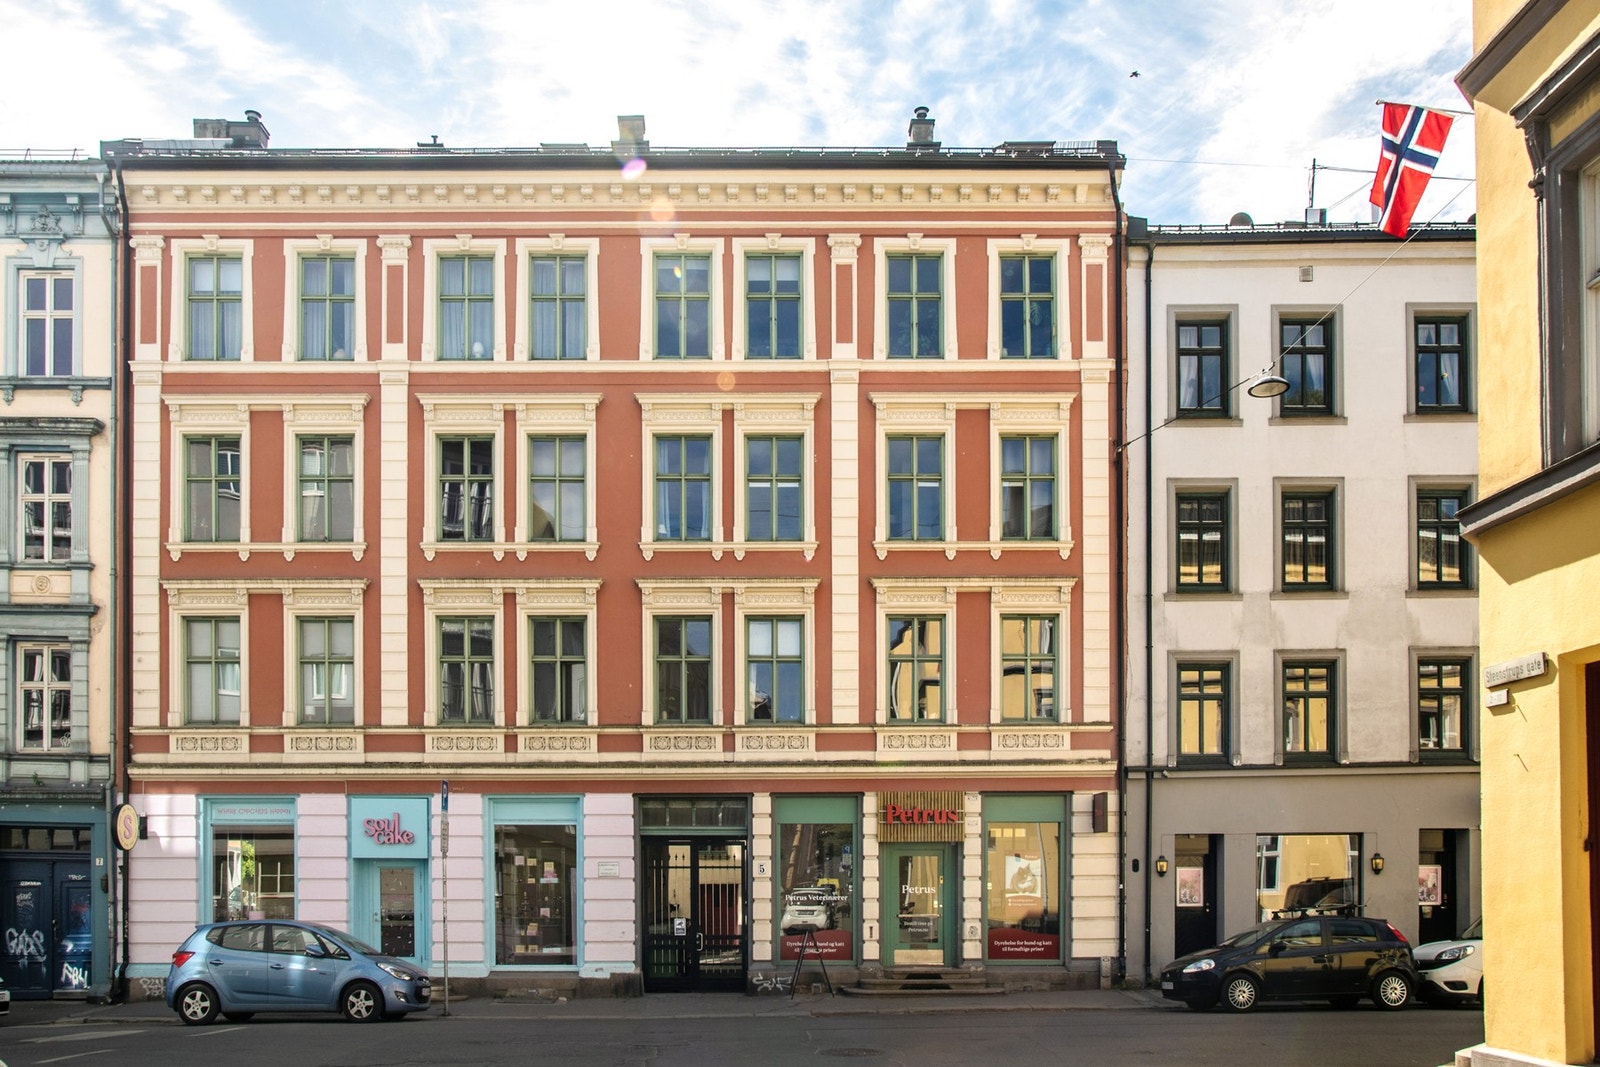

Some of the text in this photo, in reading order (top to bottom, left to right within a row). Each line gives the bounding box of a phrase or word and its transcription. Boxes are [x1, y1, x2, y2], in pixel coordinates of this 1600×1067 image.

[1485, 660, 1541, 683] Steenstrups gate
[886, 804, 959, 825] Petrus
[373, 829, 415, 845] cake
[759, 864, 765, 873] 5
[902, 884, 936, 894] Petrus
